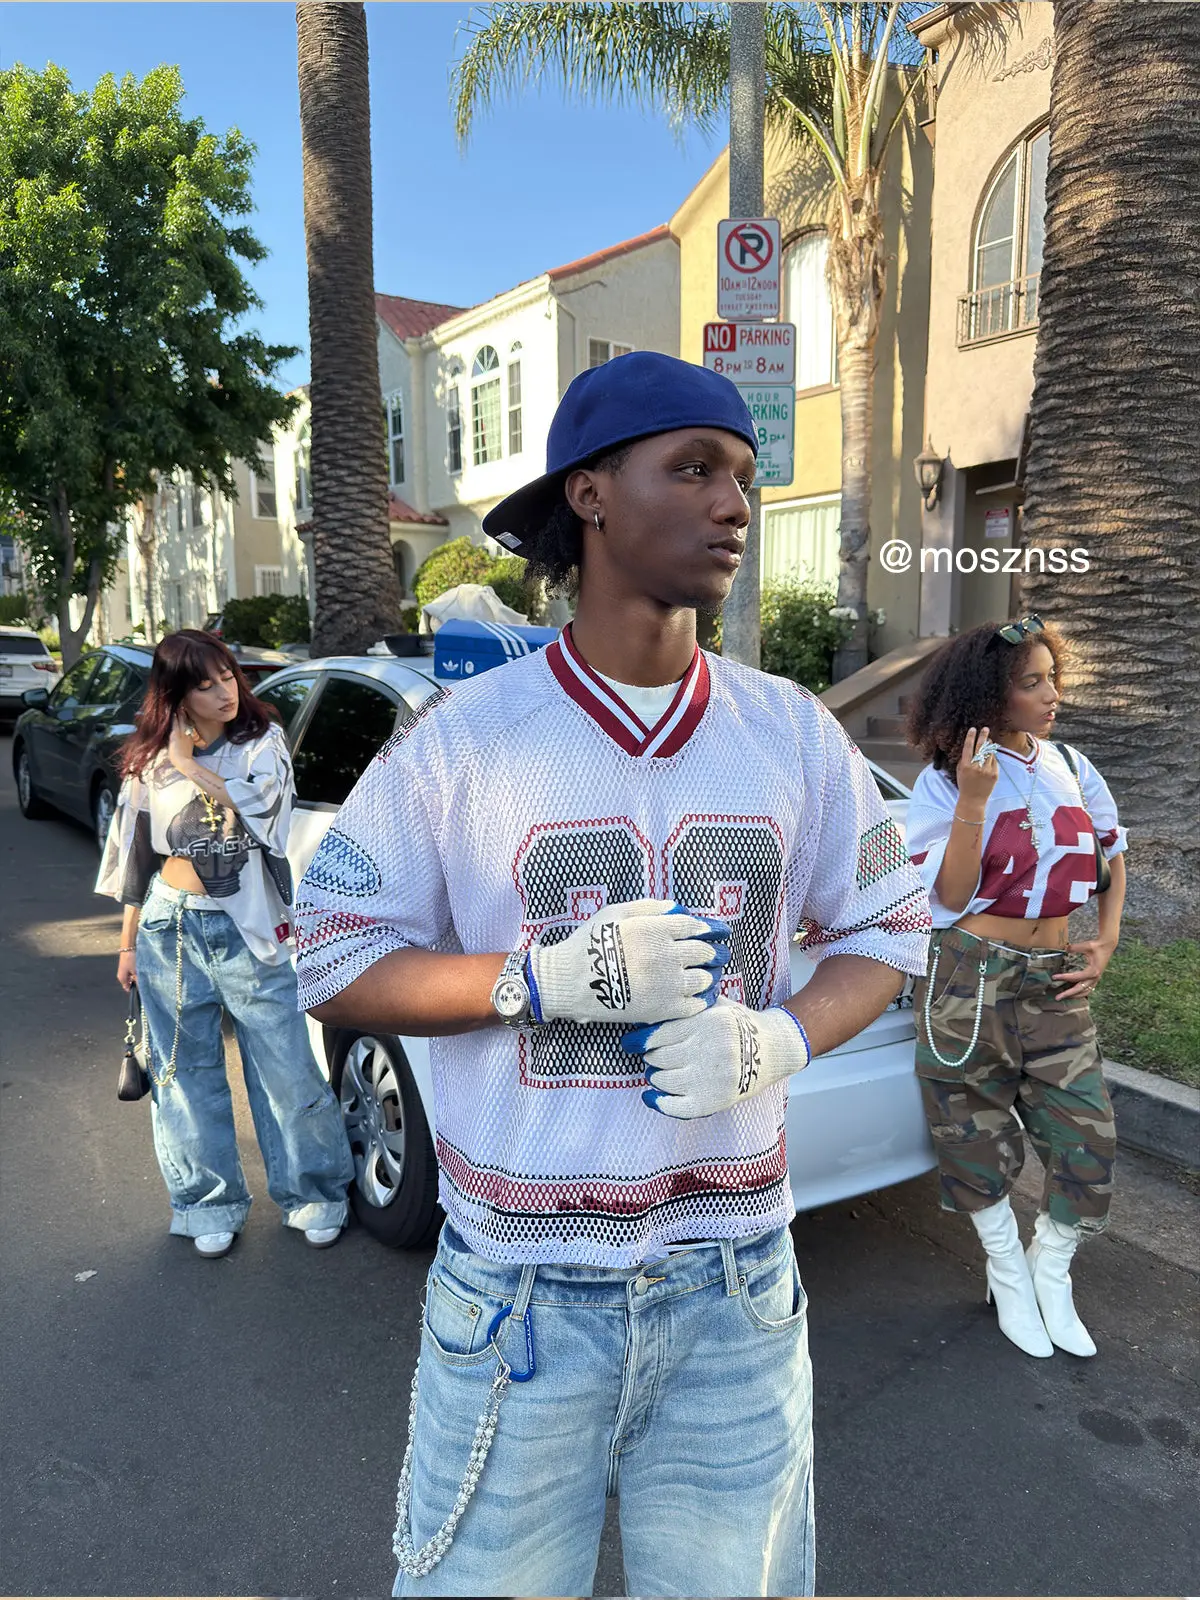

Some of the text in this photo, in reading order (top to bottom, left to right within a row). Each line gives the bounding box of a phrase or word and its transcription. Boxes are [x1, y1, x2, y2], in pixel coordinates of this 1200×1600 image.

[707, 325, 790, 349] NO PARKING
[747, 392, 779, 402] HOUR
[747, 404, 788, 420] RKING
[602, 923, 625, 1010] CREW
